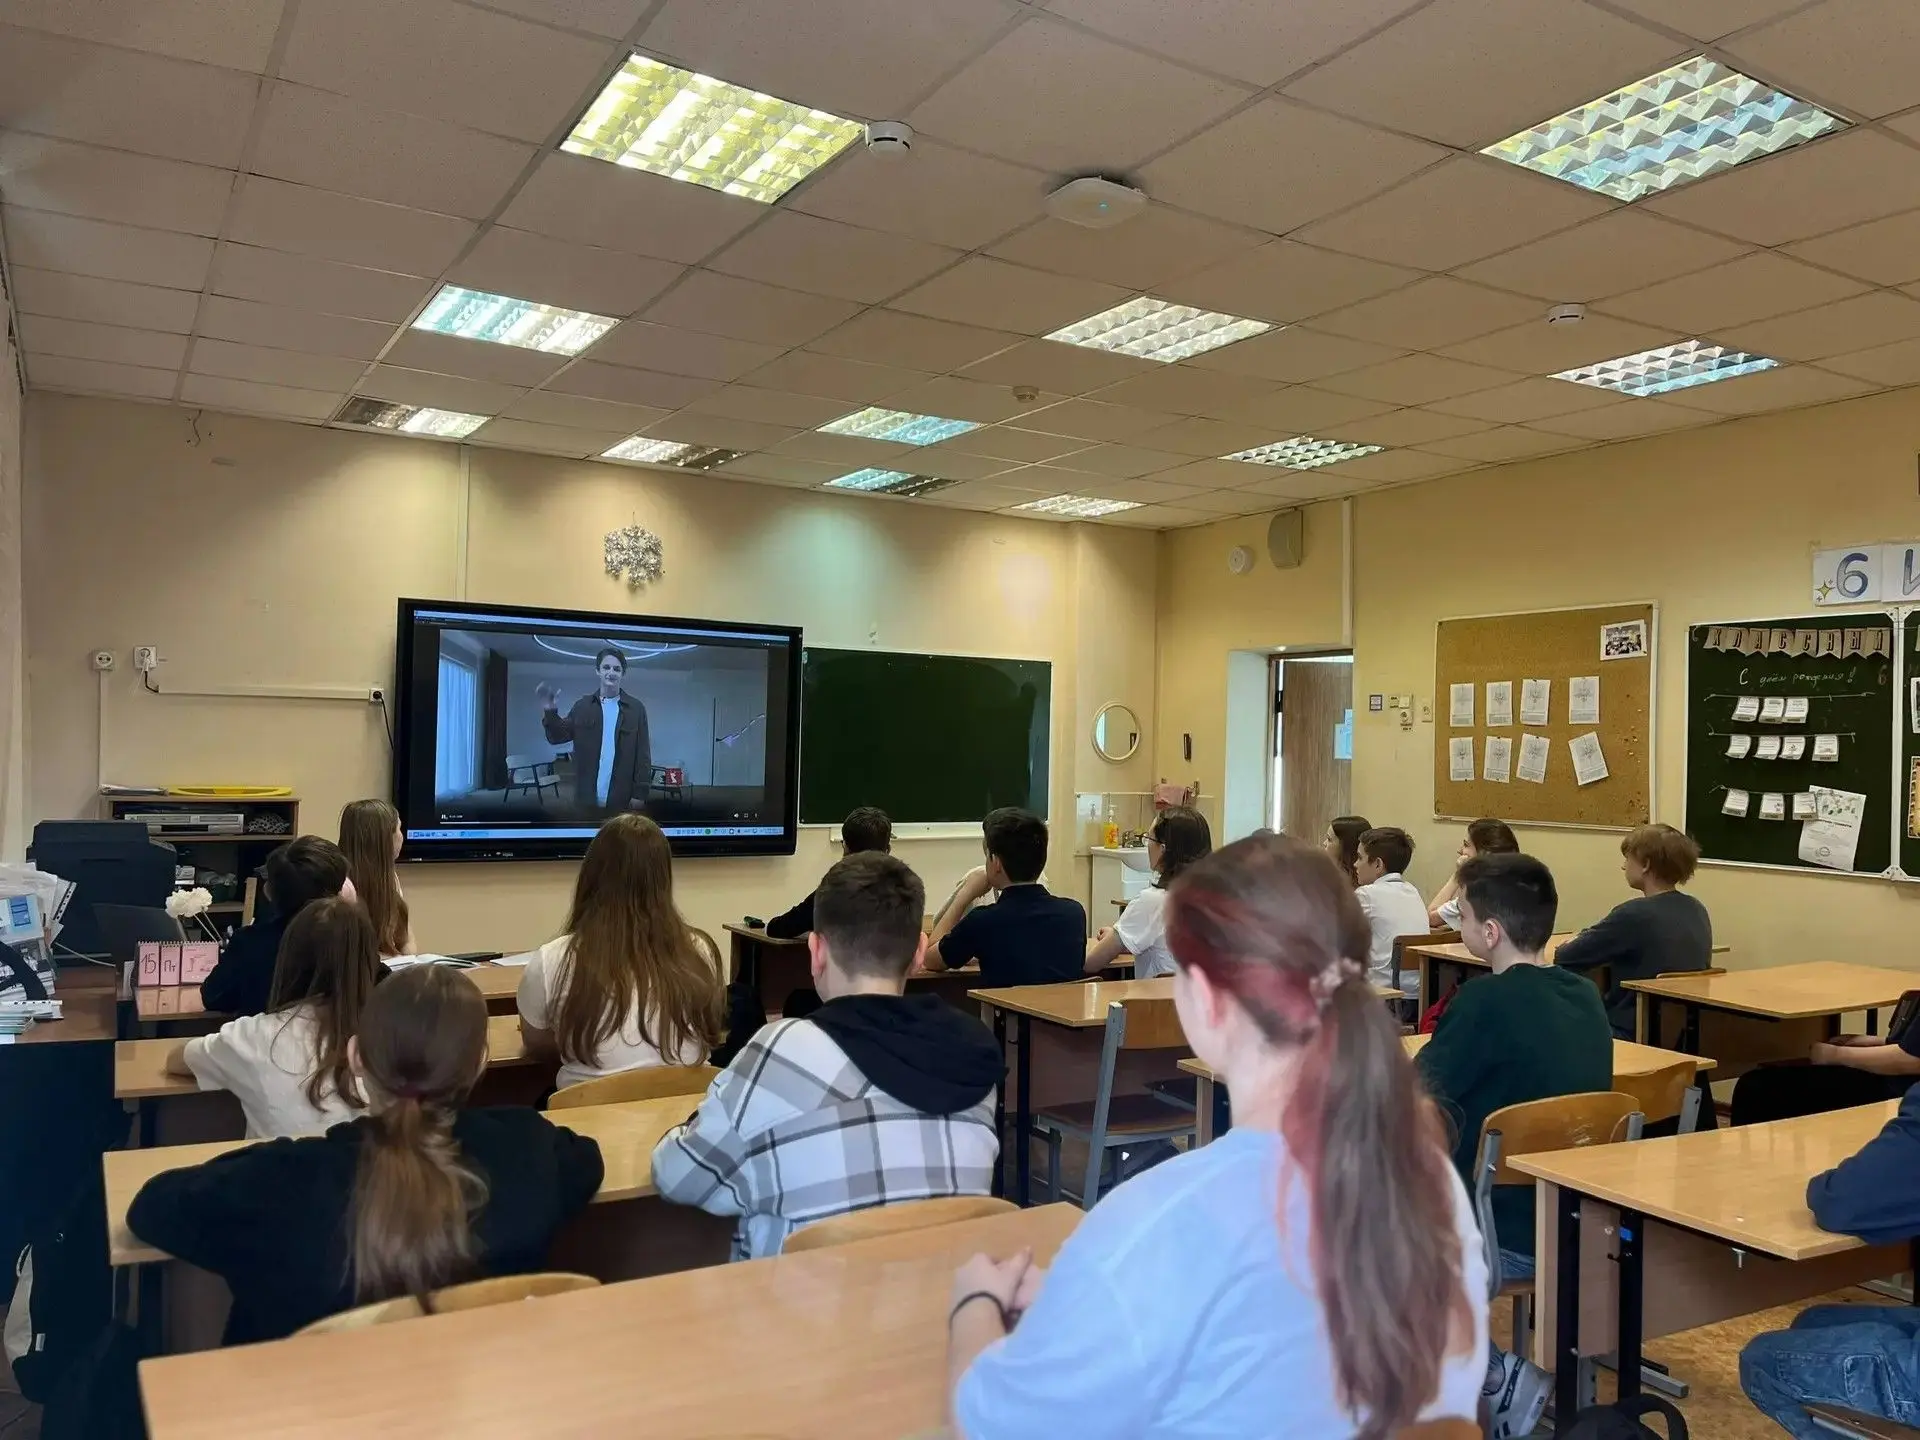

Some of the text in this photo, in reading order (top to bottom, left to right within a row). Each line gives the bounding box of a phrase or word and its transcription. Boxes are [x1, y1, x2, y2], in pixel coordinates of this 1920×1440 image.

[1837, 552, 1868, 598] 6
[1712, 628, 1883, 650] КЛАССНЫЙ
[1739, 668, 1749, 685] С
[140, 953, 156, 974] 15
